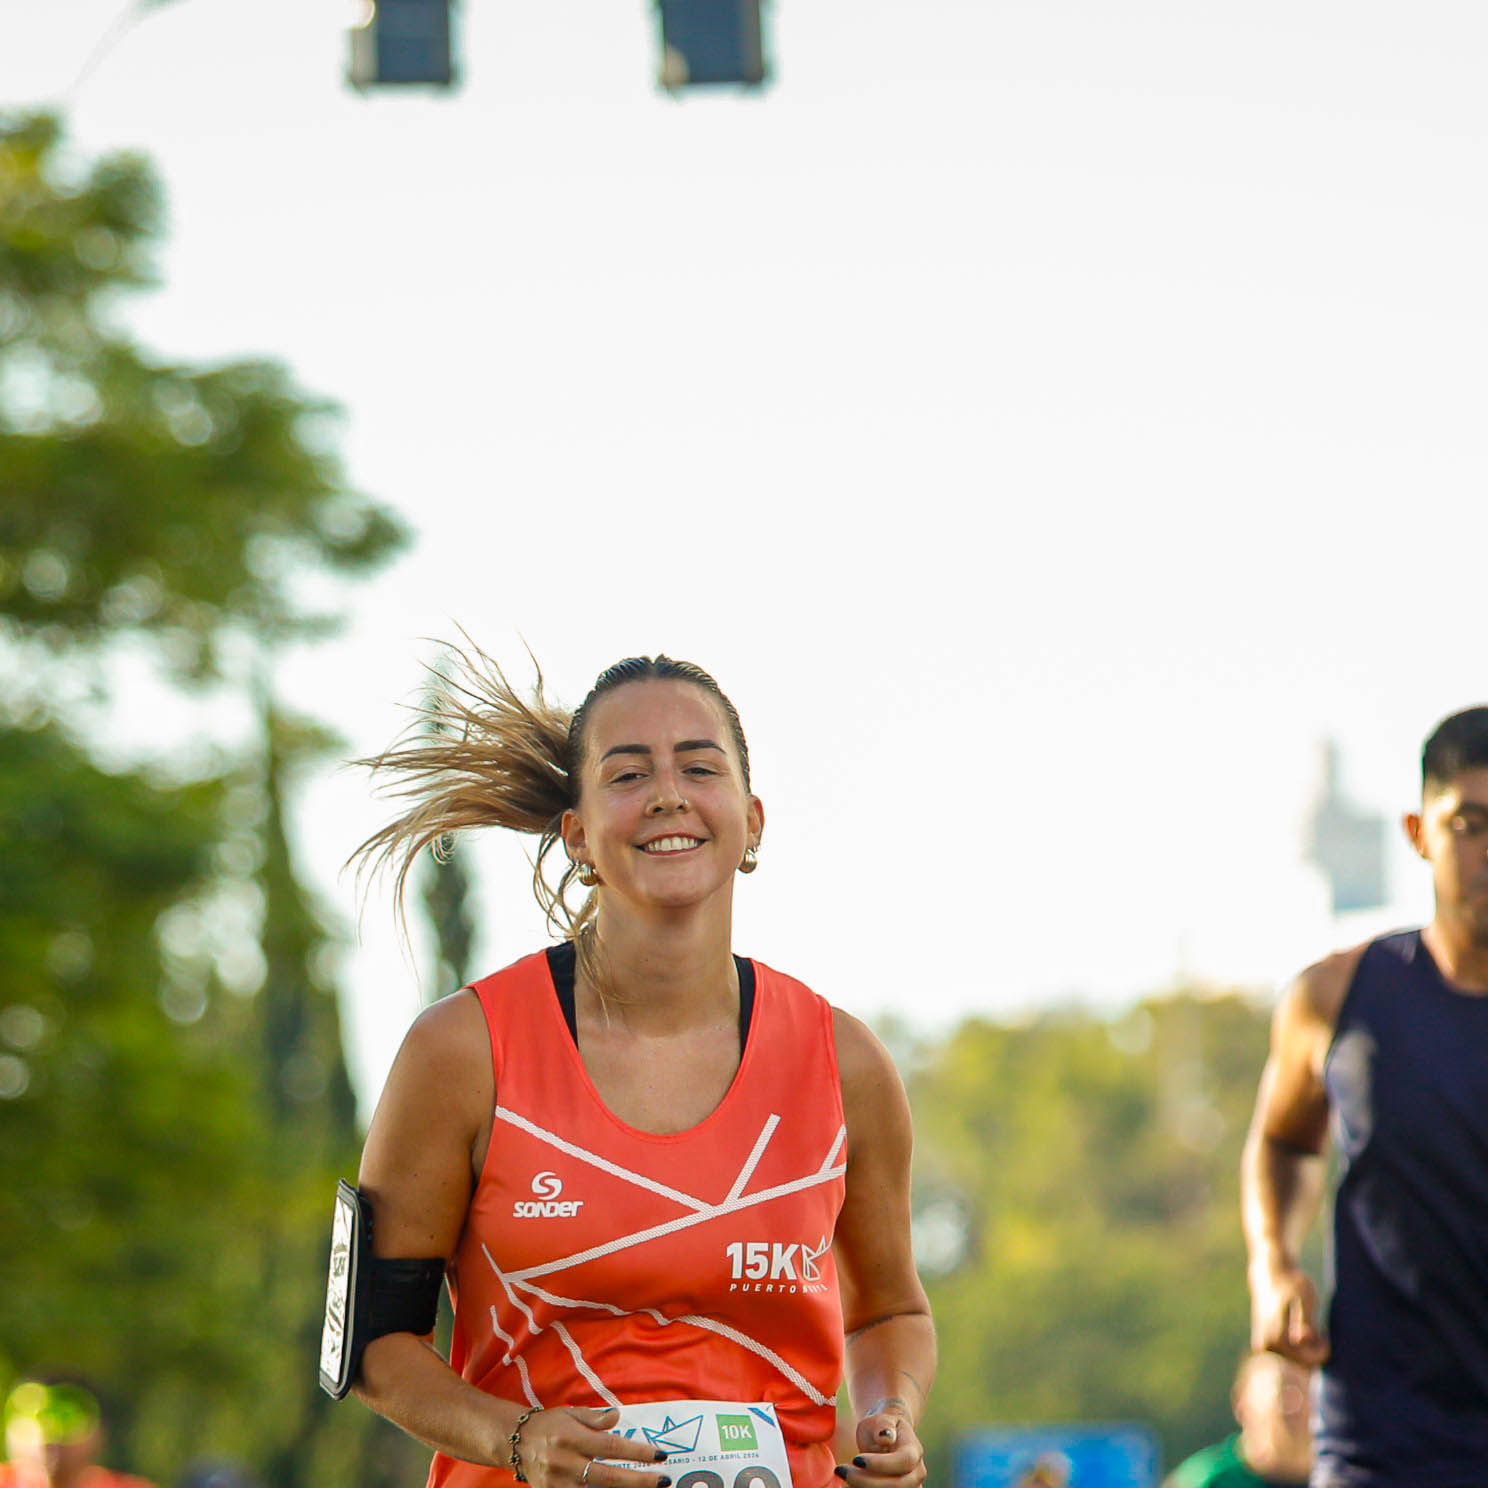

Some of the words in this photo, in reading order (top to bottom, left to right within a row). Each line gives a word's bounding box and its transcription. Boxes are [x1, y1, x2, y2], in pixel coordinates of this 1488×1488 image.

[726, 1242, 800, 1280] 15K
[729, 1283, 797, 1294] PUERTO
[721, 1424, 753, 1440] 10K
